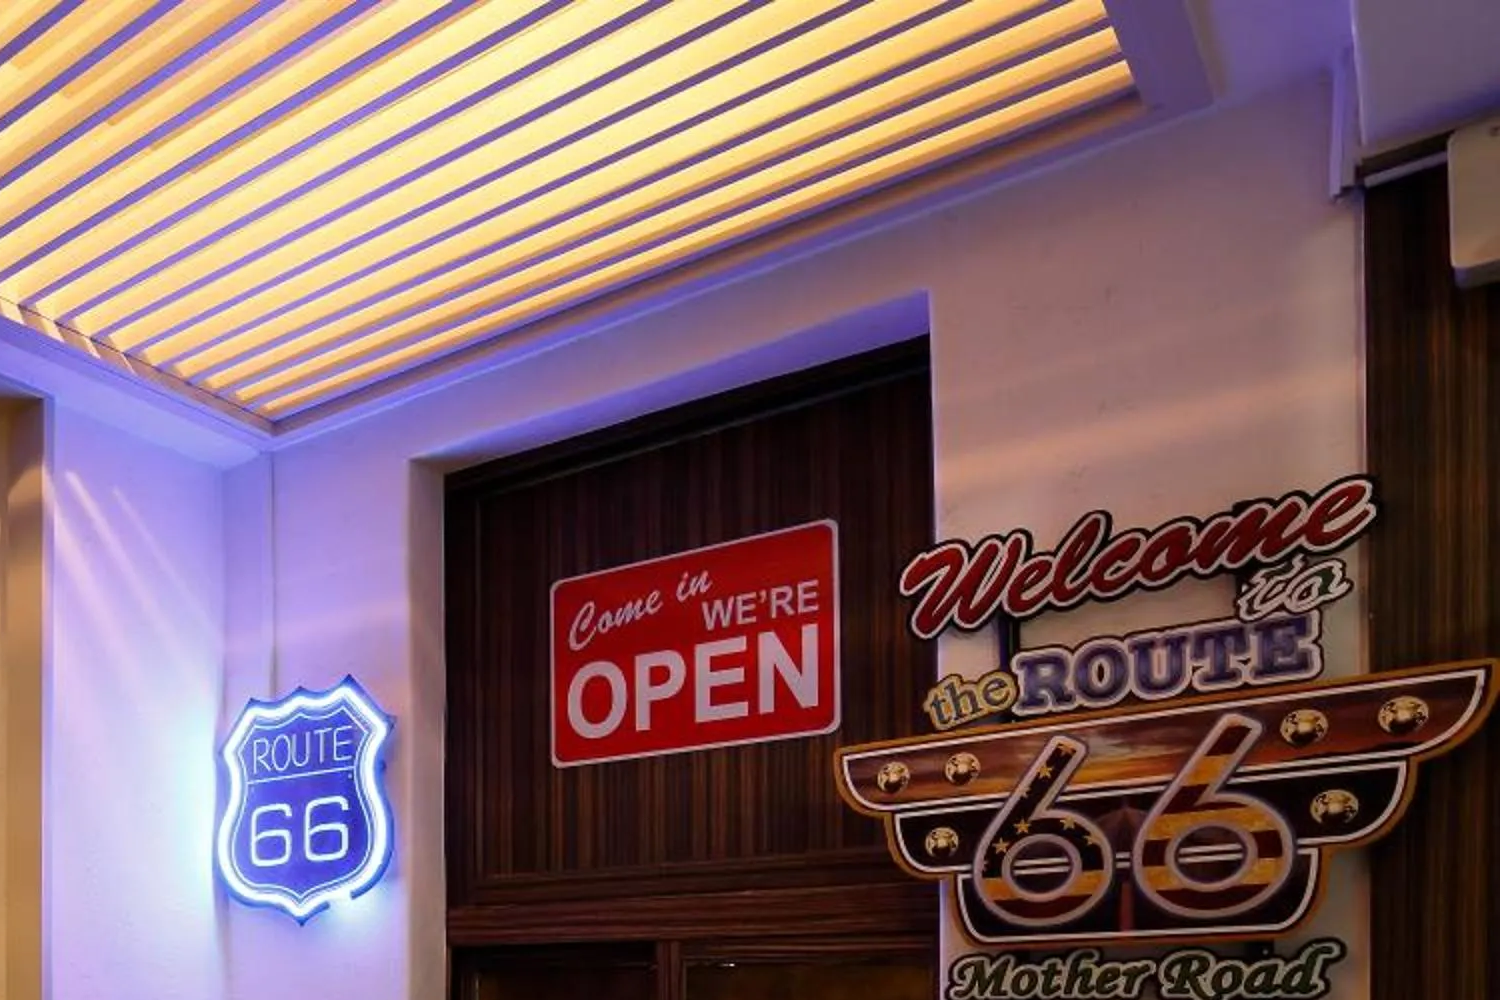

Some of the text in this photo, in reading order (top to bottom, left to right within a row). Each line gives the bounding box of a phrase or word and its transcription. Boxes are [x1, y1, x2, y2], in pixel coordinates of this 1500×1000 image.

[900, 476, 1377, 638] Welcome
[1237, 556, 1353, 622] to
[567, 570, 713, 651] Come in
[702, 579, 818, 631] WE'RE
[567, 623, 818, 740] OPEN
[923, 611, 1322, 731] the ROUTE
[252, 726, 354, 774] ROUTE
[250, 795, 350, 868] 66
[972, 713, 1298, 927] 66
